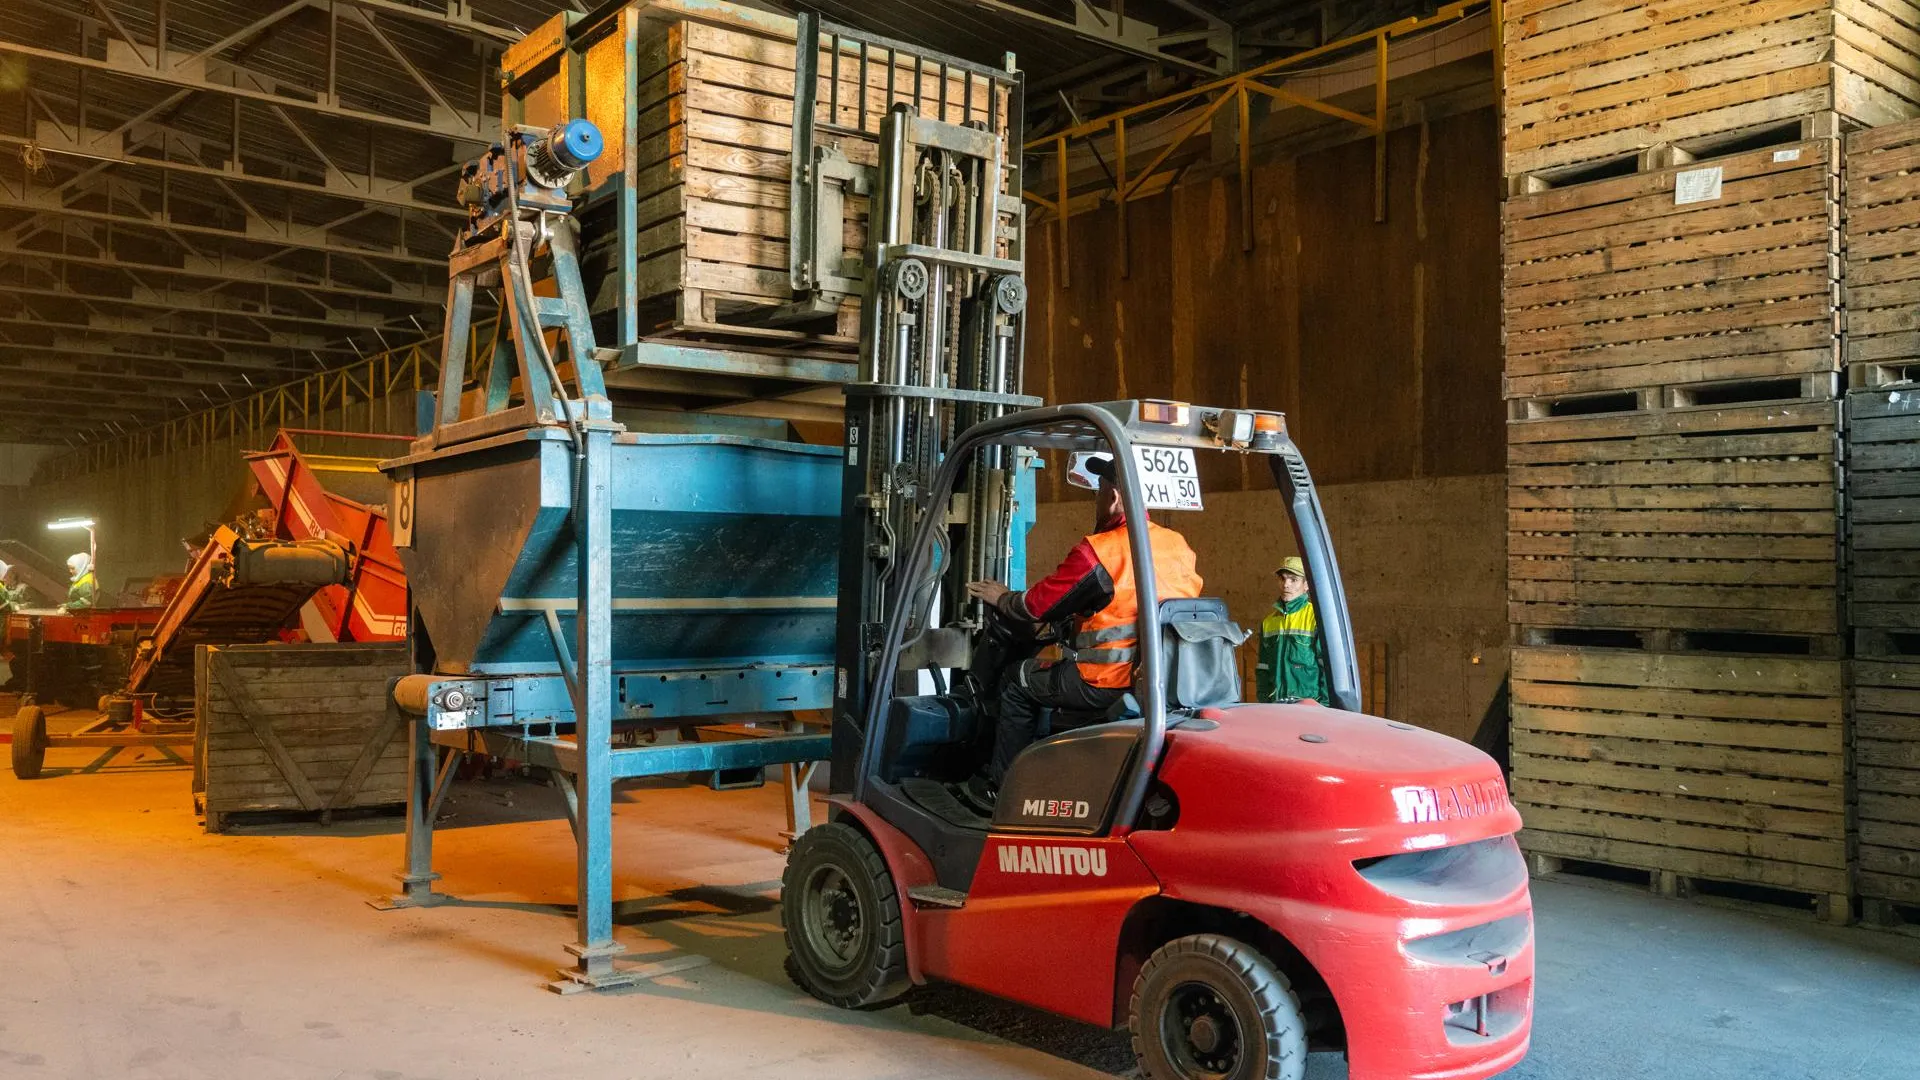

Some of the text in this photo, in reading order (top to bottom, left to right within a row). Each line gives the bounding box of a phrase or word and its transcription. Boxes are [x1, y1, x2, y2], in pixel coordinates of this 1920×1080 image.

[1141, 448, 1189, 474] 5626
[1178, 479, 1196, 498] 50
[998, 845, 1107, 877] MANITOU
